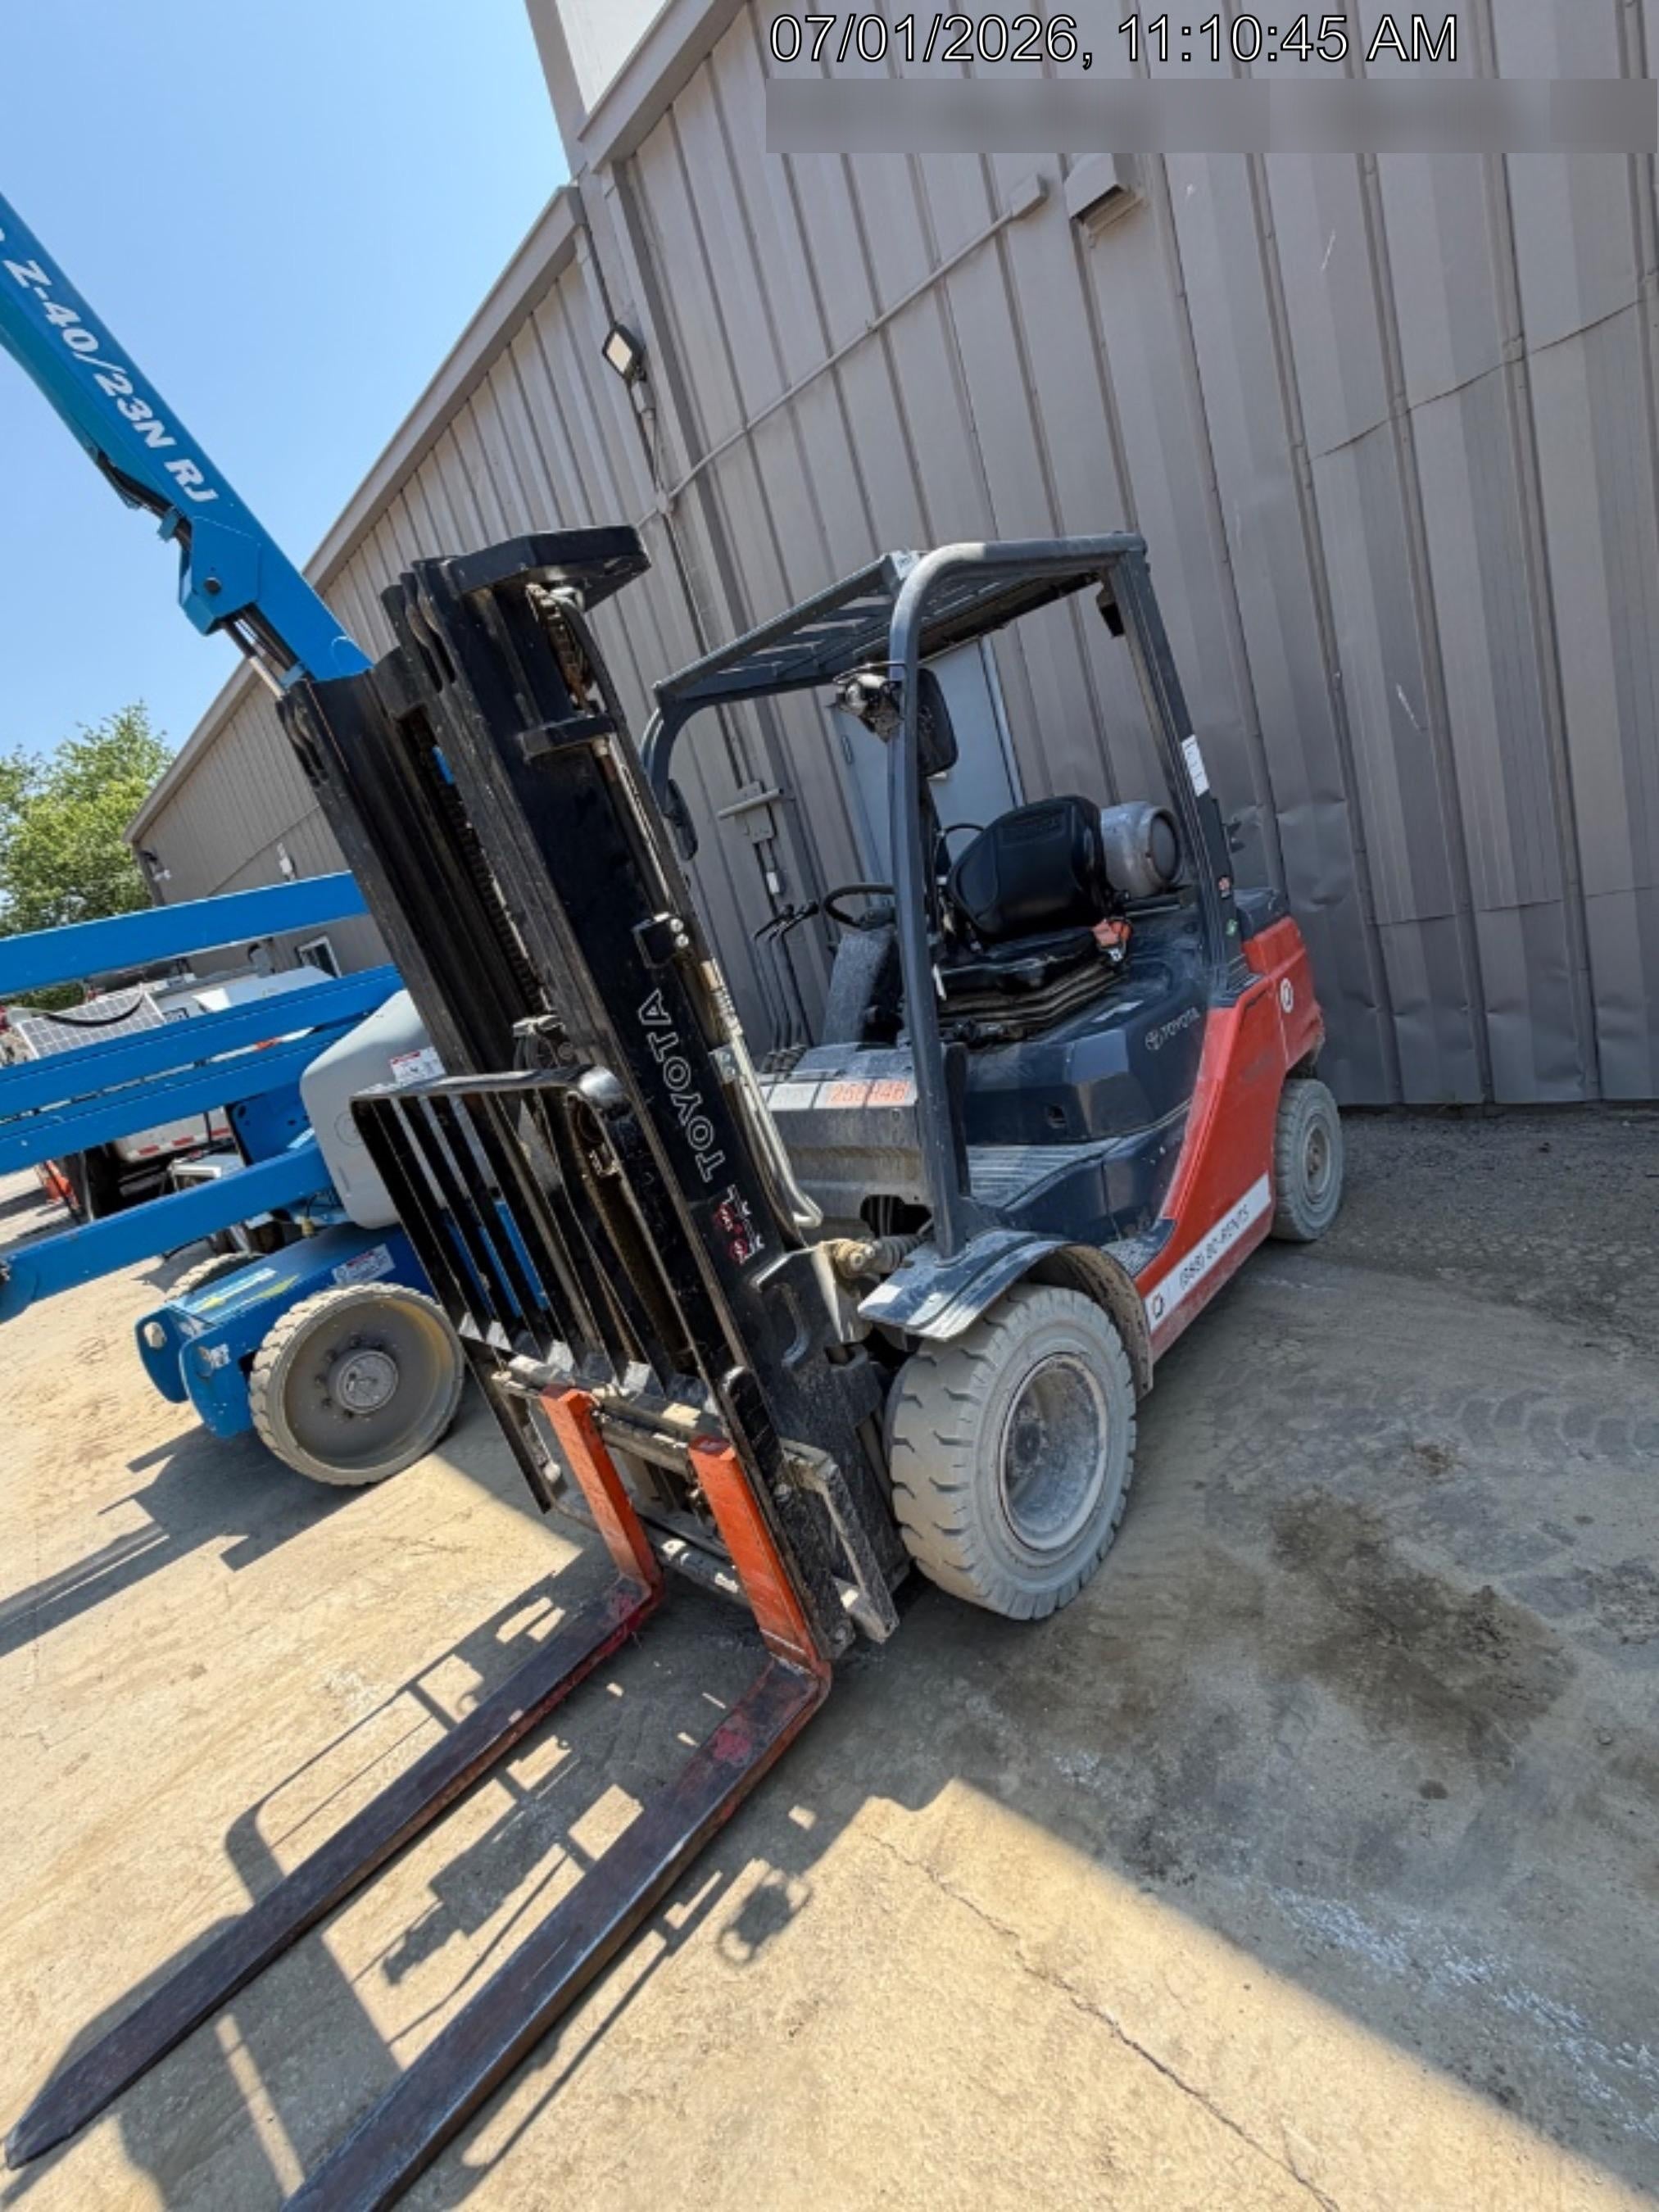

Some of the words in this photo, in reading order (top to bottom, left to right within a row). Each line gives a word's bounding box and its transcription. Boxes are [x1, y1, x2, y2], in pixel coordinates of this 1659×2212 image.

[2, 260, 177, 449] Z-40/23N
[164, 458, 220, 503] RJ
[638, 987, 726, 1183] TOYOTA
